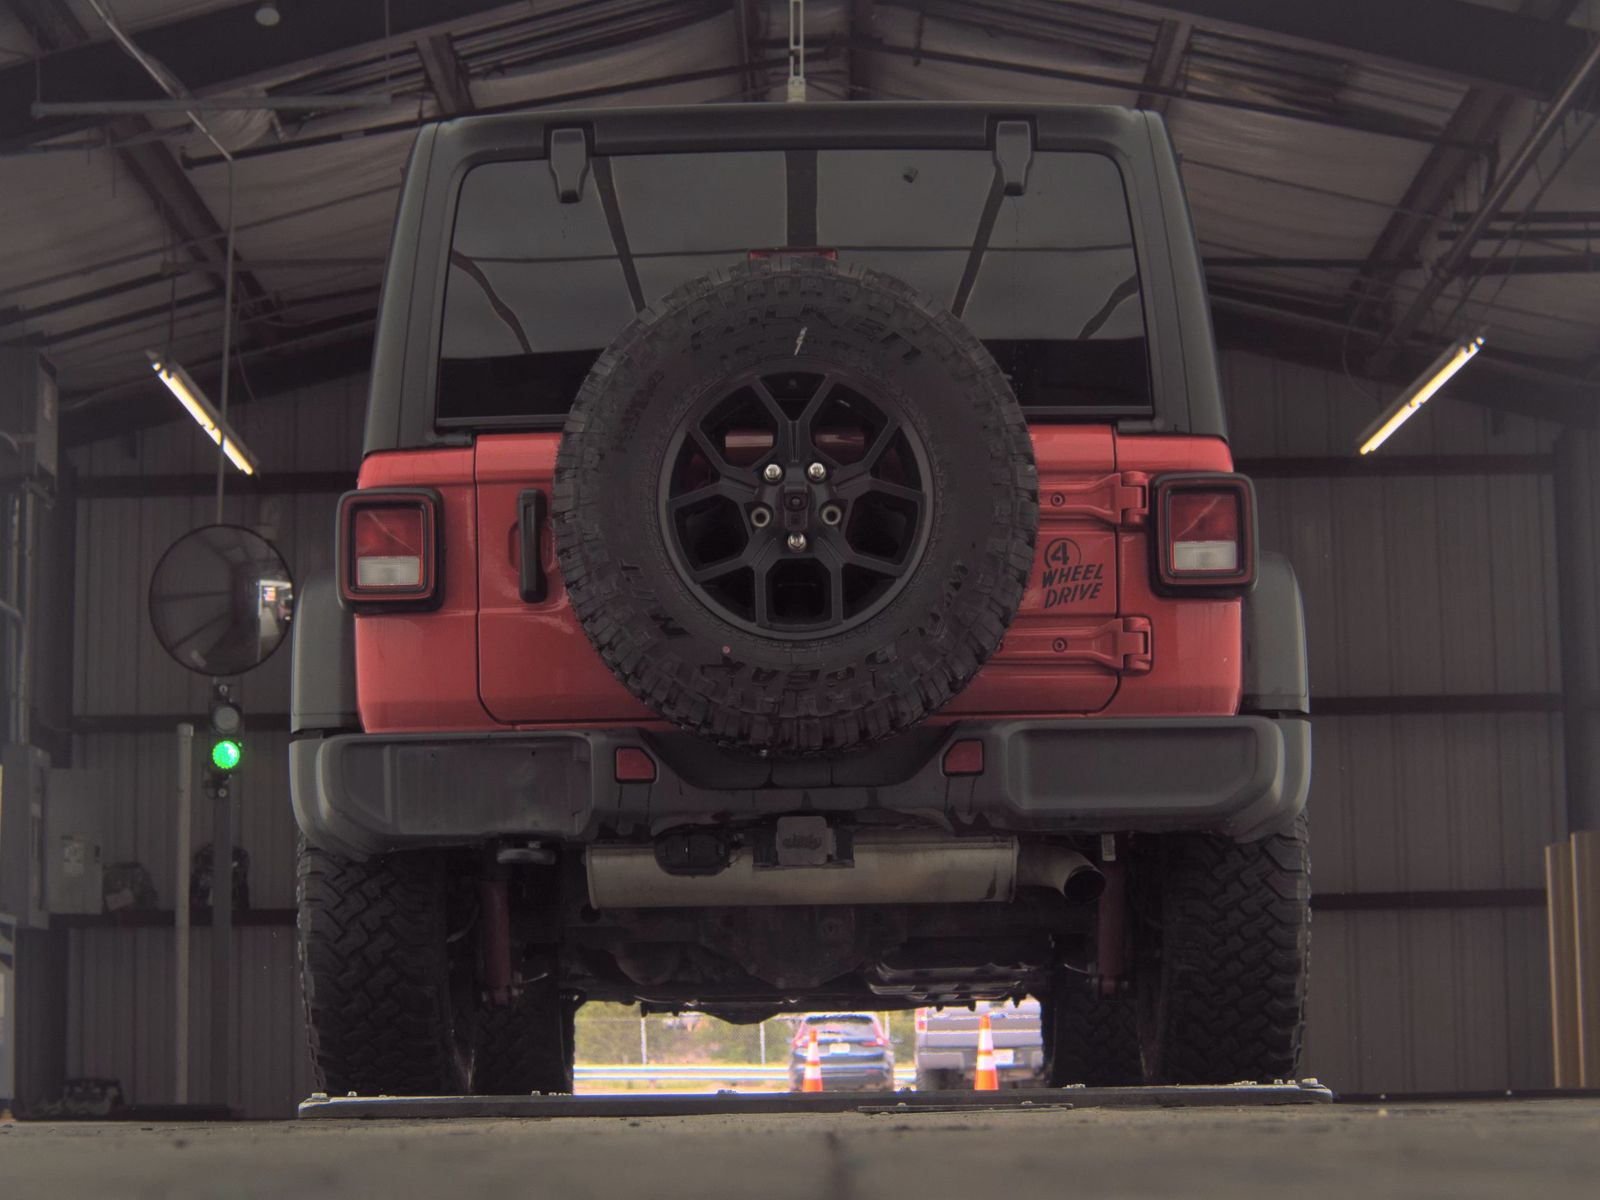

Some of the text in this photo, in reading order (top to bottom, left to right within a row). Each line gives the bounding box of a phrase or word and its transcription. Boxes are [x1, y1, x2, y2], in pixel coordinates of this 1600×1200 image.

[1051, 541, 1070, 565] 4
[1041, 563, 1105, 589] WHEEL
[1044, 582, 1104, 609] DRIVE
